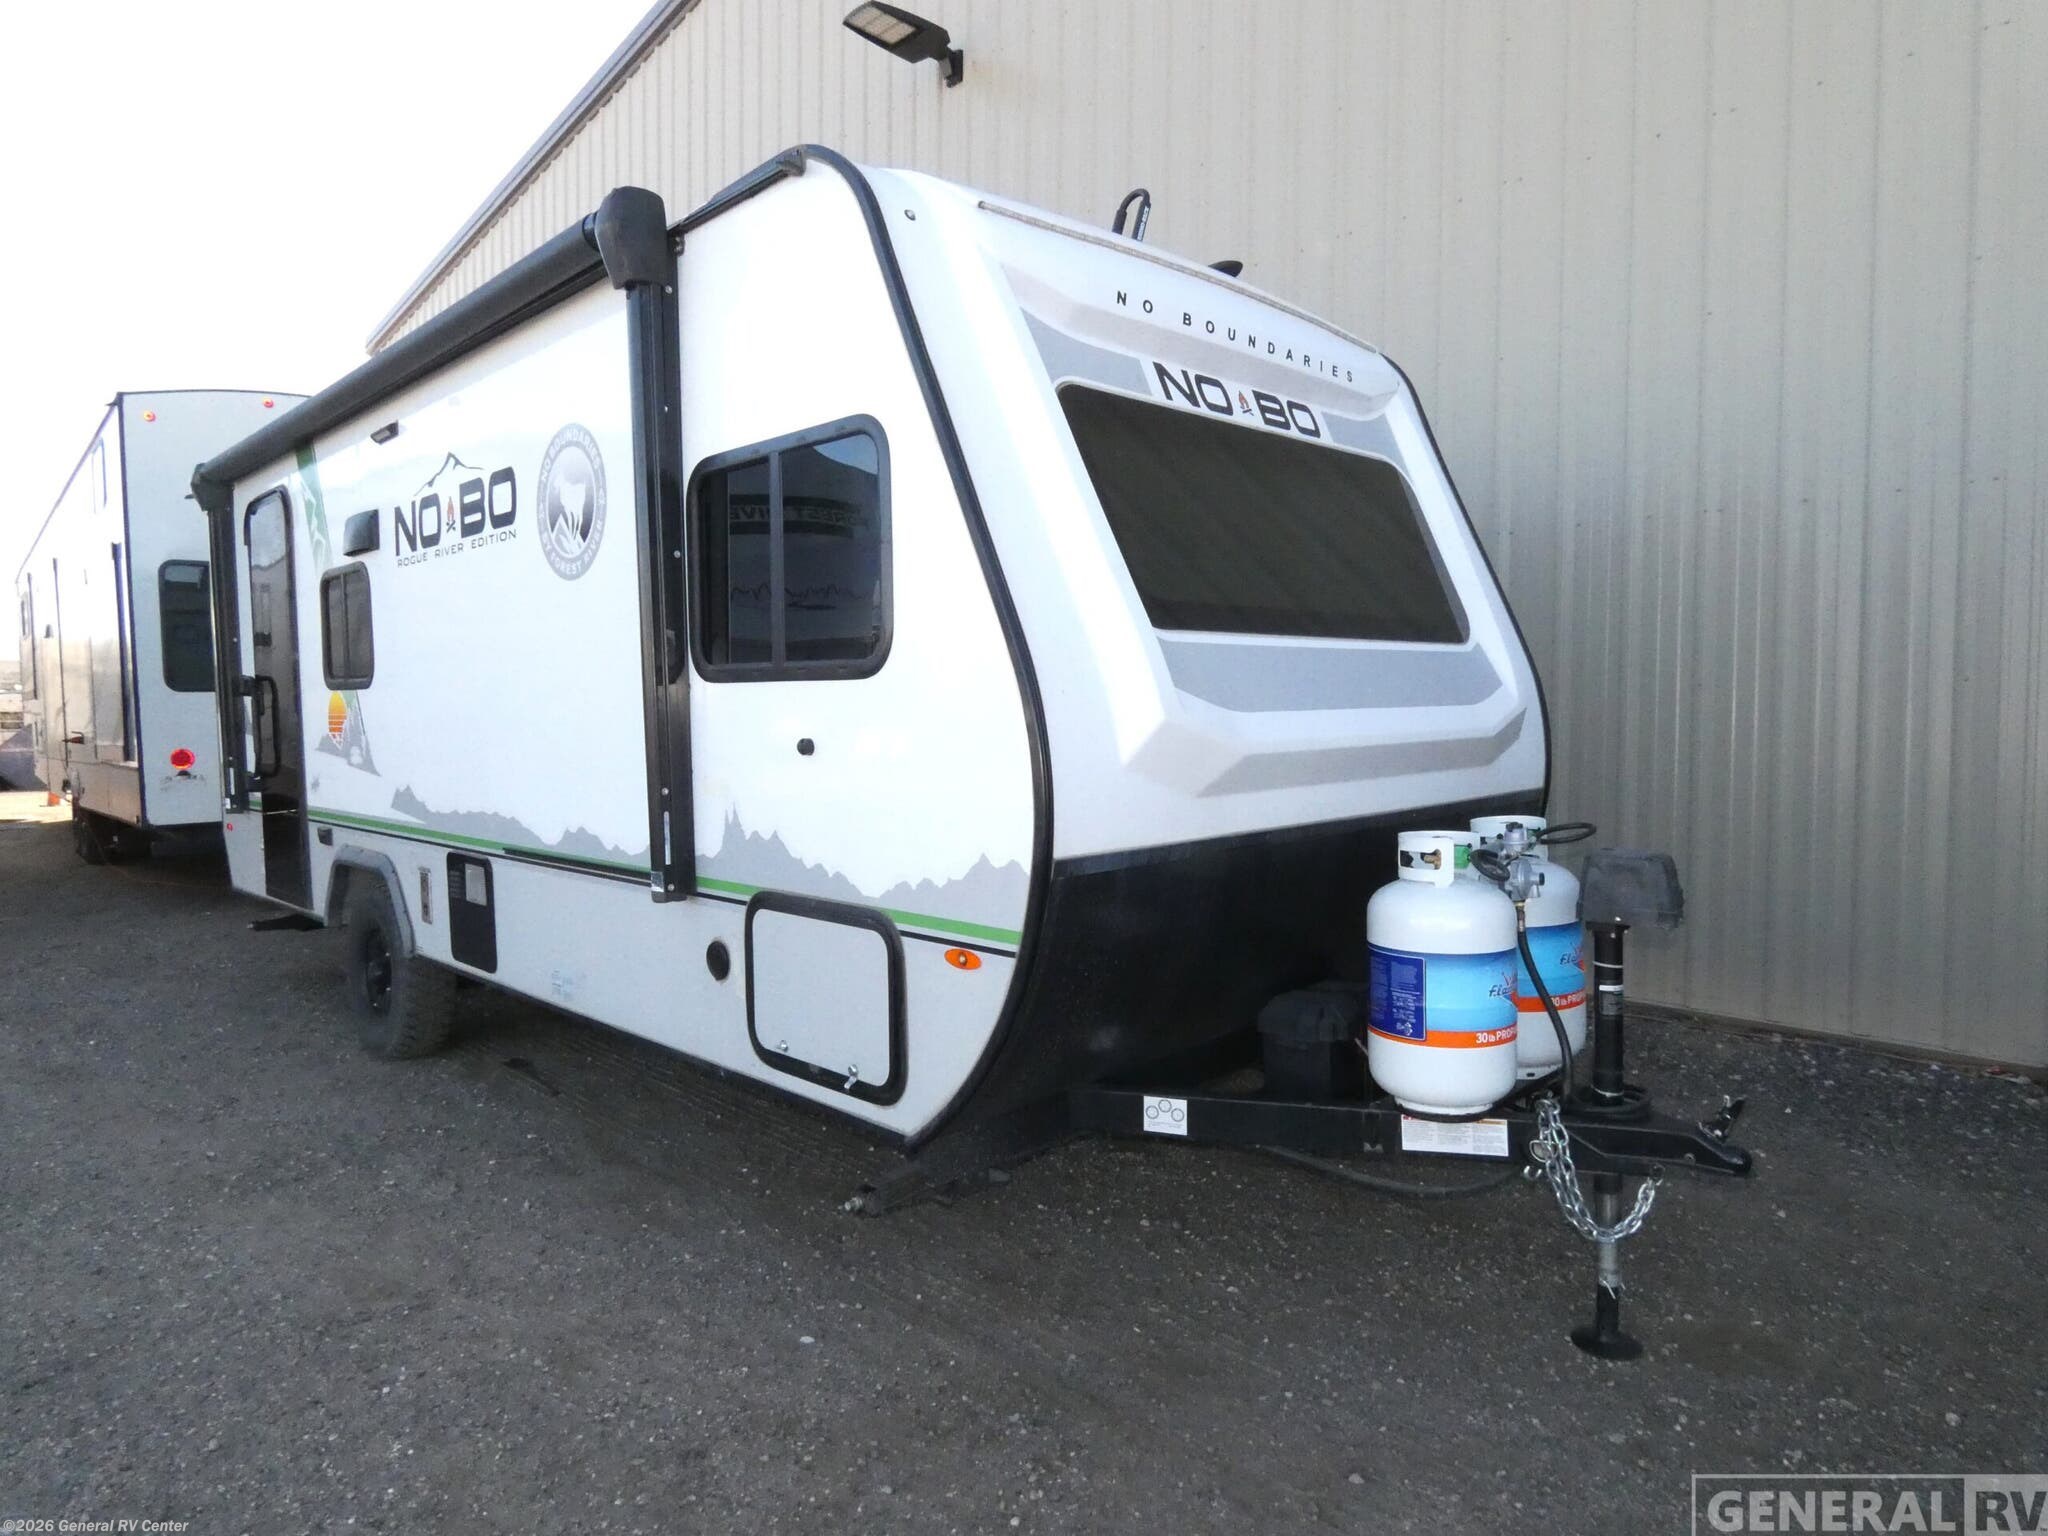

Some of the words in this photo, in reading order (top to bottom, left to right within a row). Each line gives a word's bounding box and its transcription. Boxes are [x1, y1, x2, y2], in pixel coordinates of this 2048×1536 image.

[1116, 290, 1154, 314] NO
[1182, 312, 1353, 383] BOUNDARIES
[397, 552, 428, 568] ROGUE
[434, 542, 464, 559] RIVER
[471, 529, 517, 549] EDITION
[1476, 1032, 1488, 1043] 30
